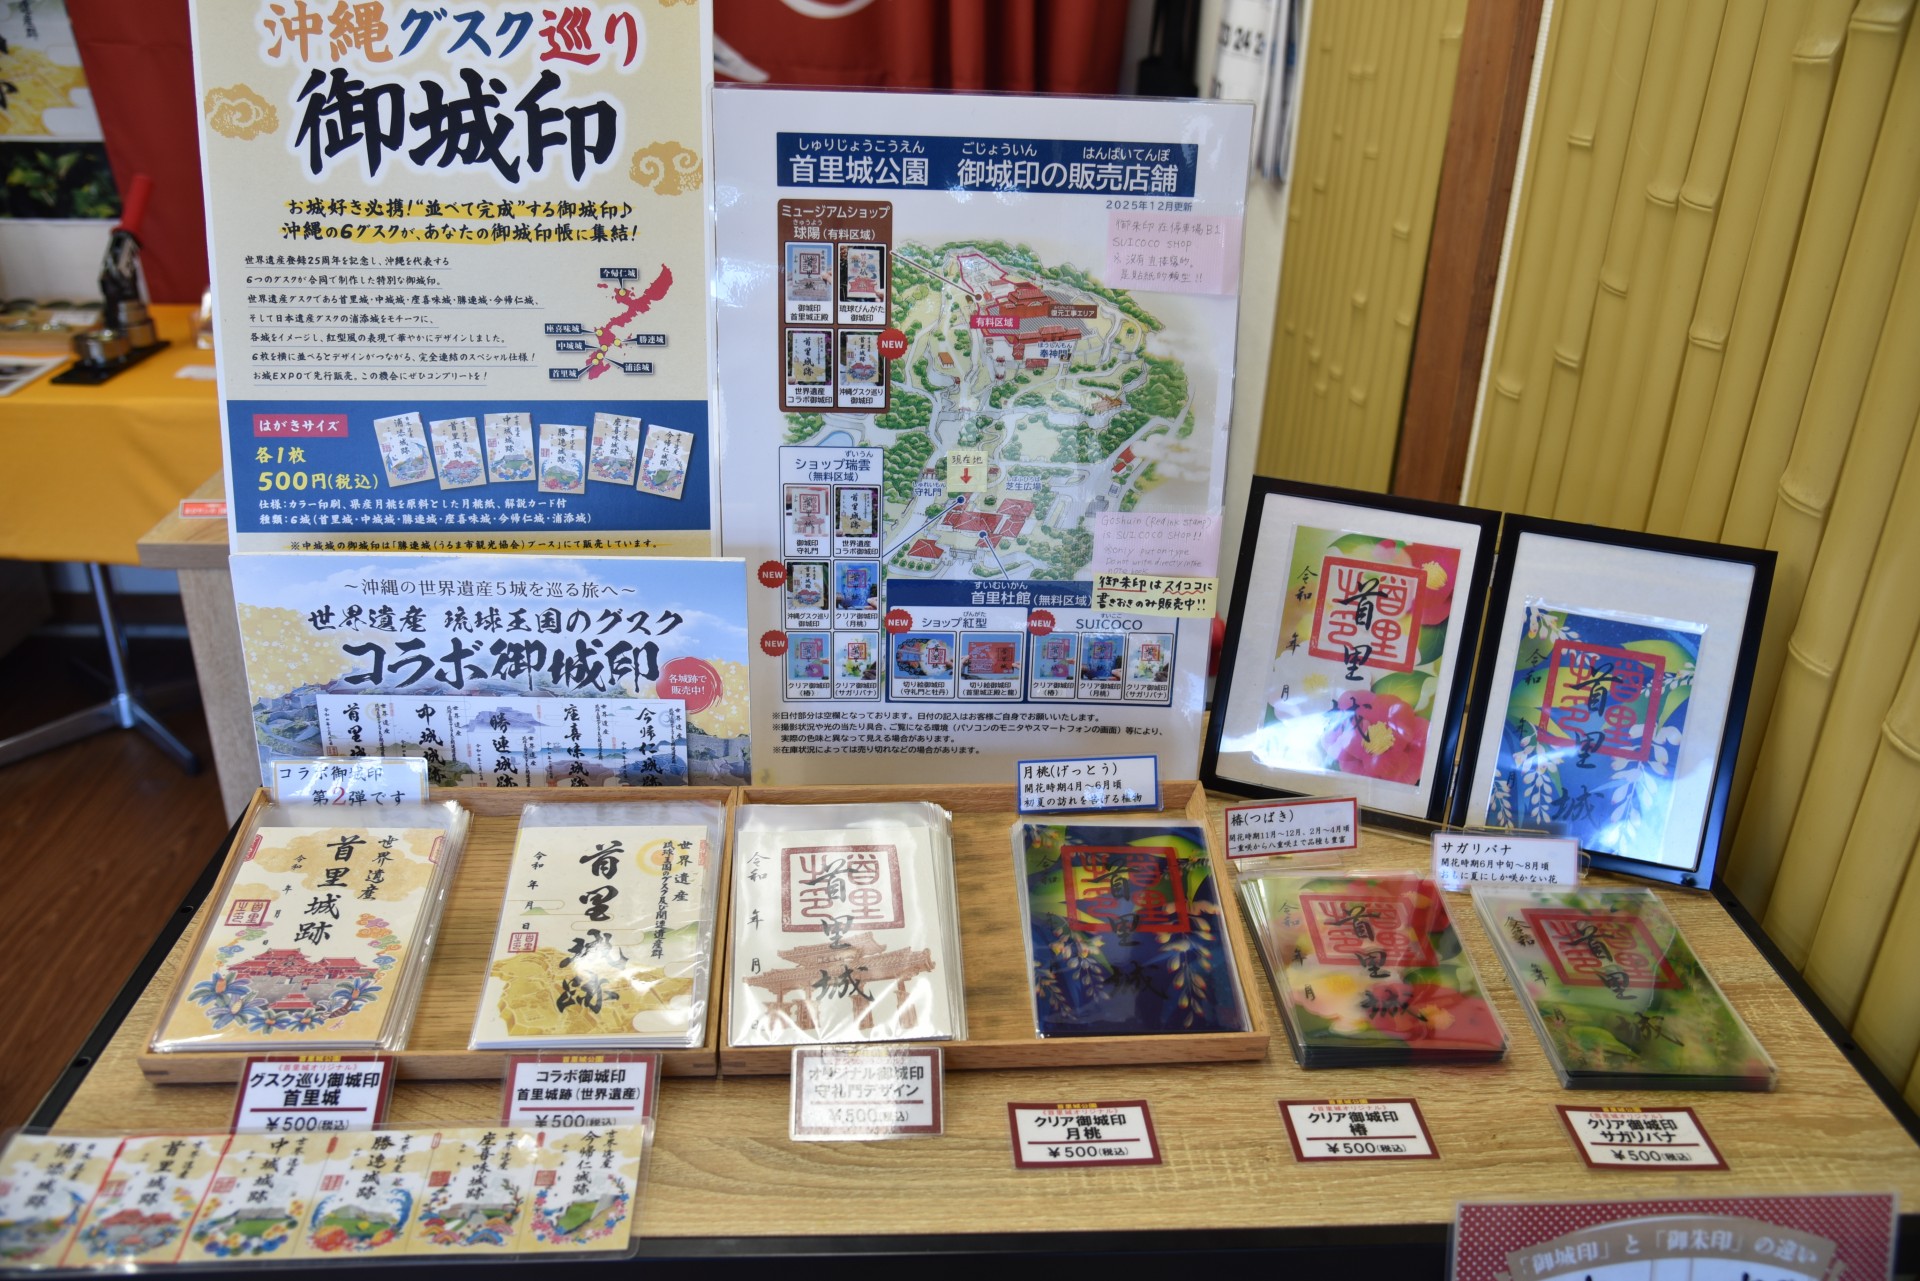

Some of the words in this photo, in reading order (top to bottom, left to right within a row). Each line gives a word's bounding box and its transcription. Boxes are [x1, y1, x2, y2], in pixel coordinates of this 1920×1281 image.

[263, 1, 638, 66] 沖縄グスク巡り
[294, 68, 617, 183] 御城印
[799, 138, 925, 154] しゅりじょうこうえん
[962, 142, 1038, 157] ごじょういん
[1083, 147, 1170, 162] はんばいてんぽ
[789, 154, 928, 186] 首里城公園
[957, 159, 1178, 192] 御城印の販売店舗
[782, 205, 890, 219] ミュージアムショップ
[1106, 200, 1192, 212] 2025年12月更新
[245, 255, 450, 266] 世界遺産登録25周年を記念し、沖縄を代表する
[603, 269, 635, 278] 今帰仁城
[246, 275, 441, 285] 6つのグスクが合同で制作した特別な御城印。
[798, 304, 821, 312] 御城印
[839, 305, 885, 313] 琉球びんがた
[250, 314, 434, 324] そして日本遺産グスクの浦添城をモチーフに、
[790, 313, 829, 321] 首里城正殿
[851, 314, 874, 322] 御城印
[976, 318, 1013, 327] 有料区域
[546, 325, 580, 333] 座喜味城
[251, 332, 506, 343] 各城をイメージし、紅型風の表現で華やかにデザインしました。
[553, 370, 577, 378] 首里城
[625, 364, 650, 372] 浦添城
[839, 388, 883, 396] 沖縄グスク巡り
[259, 418, 339, 432] はがきサイズ
[255, 446, 306, 463] 各1枚
[952, 455, 983, 464] 現在地
[795, 458, 871, 472] ショップ瑞雲
[258, 471, 378, 491] 500円(税込)
[1006, 482, 1041, 491] 芝生広場
[914, 488, 941, 496] 守礼門
[762, 571, 783, 579] NEW
[974, 581, 1028, 590] すいむいかん
[308, 606, 427, 633] 世界遺産
[444, 608, 684, 636] 琉球王国のグスク
[922, 618, 987, 628] ショップ紅型
[1076, 619, 1142, 630] SUICOCO
[765, 640, 785, 648] NEW
[342, 636, 661, 693] コラボ御城印
[669, 674, 707, 683] 各城跡で
[671, 685, 704, 695] 販売中!
[279, 765, 382, 782] コラボ御城印
[312, 786, 406, 806] 第2弾です
[1231, 810, 1294, 826] 椿(つばき)
[1229, 836, 1346, 852] 一重咲から八重咲まで品種も豊富
[1442, 843, 1511, 855] サガリバナ
[531, 851, 547, 869] 令和
[357, 835, 398, 900] 世界遺産
[672, 841, 693, 902] 世界遺産
[1441, 871, 1557, 883] おもに夏にしか咲かない花
[295, 835, 366, 945] 首里城跡
[556, 840, 629, 1014] 首里城跡
[804, 859, 875, 1001] 首里城
[250, 1073, 380, 1088] グスク巡り御城印
[536, 1069, 625, 1083] コラボ御城印
[517, 1088, 640, 1100] 首里城跡(世界遺産)
[815, 1085, 919, 1097] 守礼門デザイン
[283, 1089, 341, 1106] 首里城
[1035, 1114, 1126, 1127] クリア御城印
[1308, 1111, 1398, 1123] クリア御城印
[1349, 1123, 1367, 1136] 椿
[1588, 1119, 1677, 1130] クリア御城印
[1067, 1127, 1102, 1140] 月桃
[1600, 1131, 1676, 1143] サガリバナ
[466, 1132, 497, 1200] 座喜味城跡
[572, 1130, 600, 1195] 今帰仁城跡
